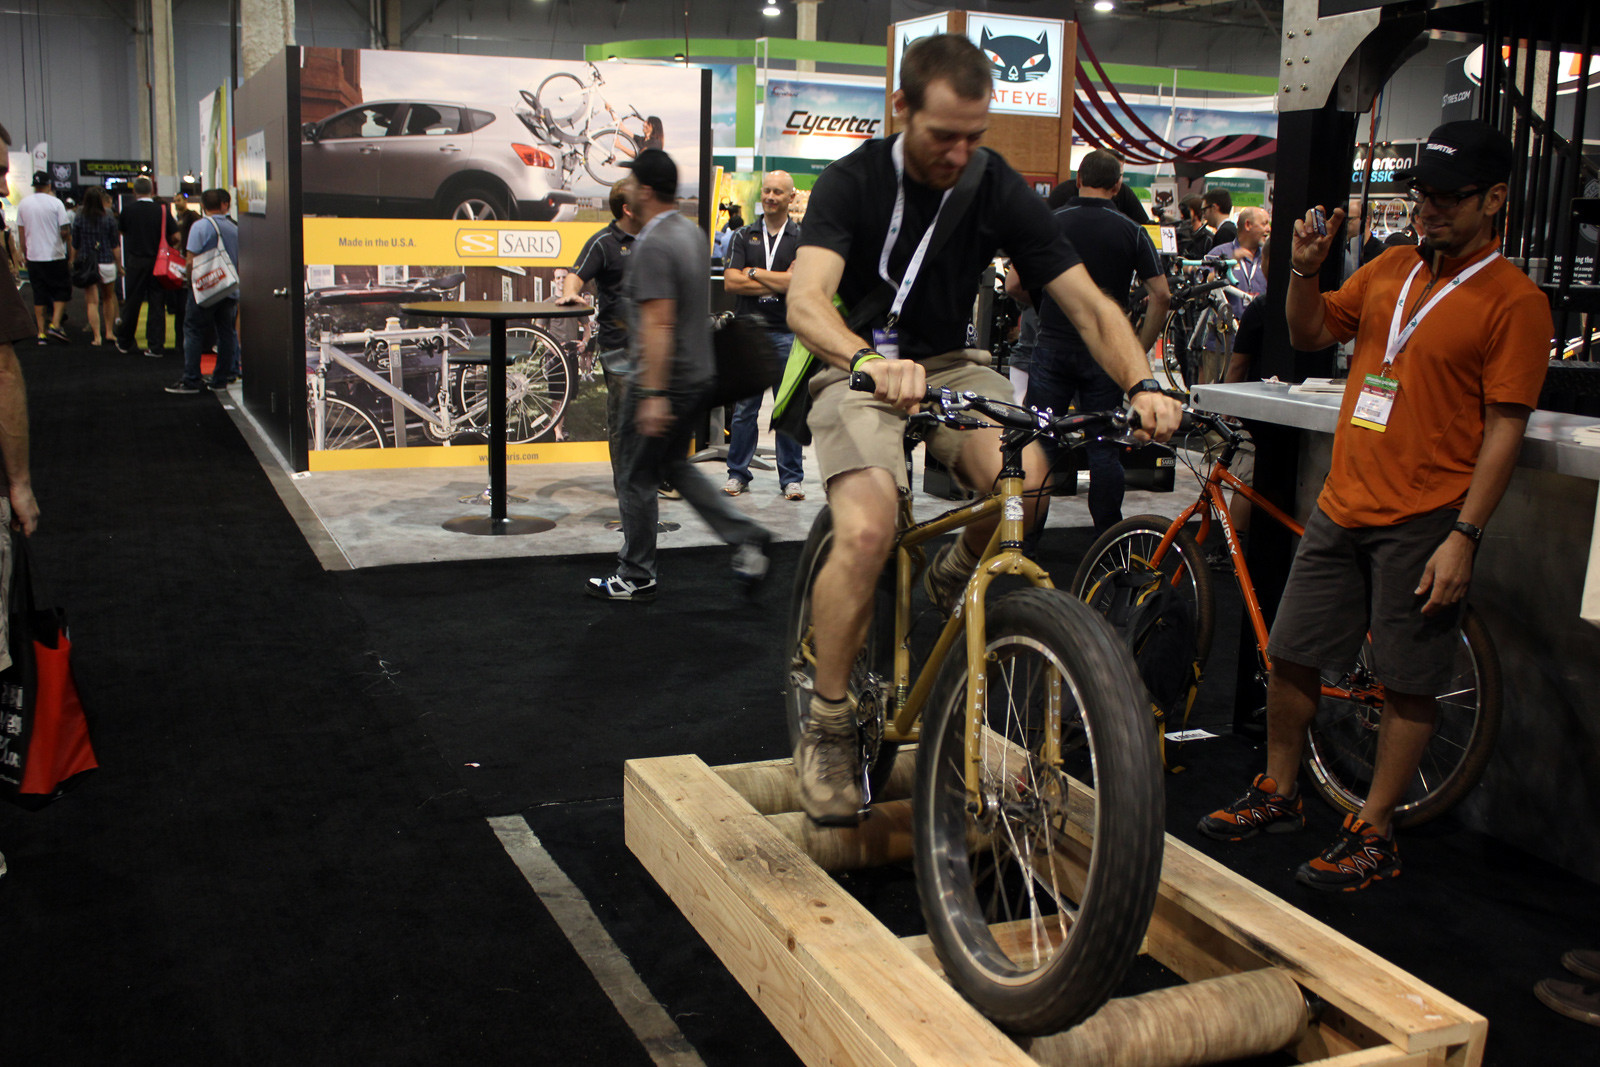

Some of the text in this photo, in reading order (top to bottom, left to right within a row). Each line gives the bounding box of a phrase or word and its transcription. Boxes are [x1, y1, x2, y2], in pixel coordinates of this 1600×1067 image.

[991, 89, 1047, 106] ATEYE
[786, 110, 881, 135] Cycertec
[1352, 170, 1395, 183] CLSSIC
[338, 237, 416, 247] Made in the U.S.A.
[503, 233, 555, 254] SARIS
[1219, 509, 1237, 555] SURLY
[973, 672, 985, 739] SURLY
